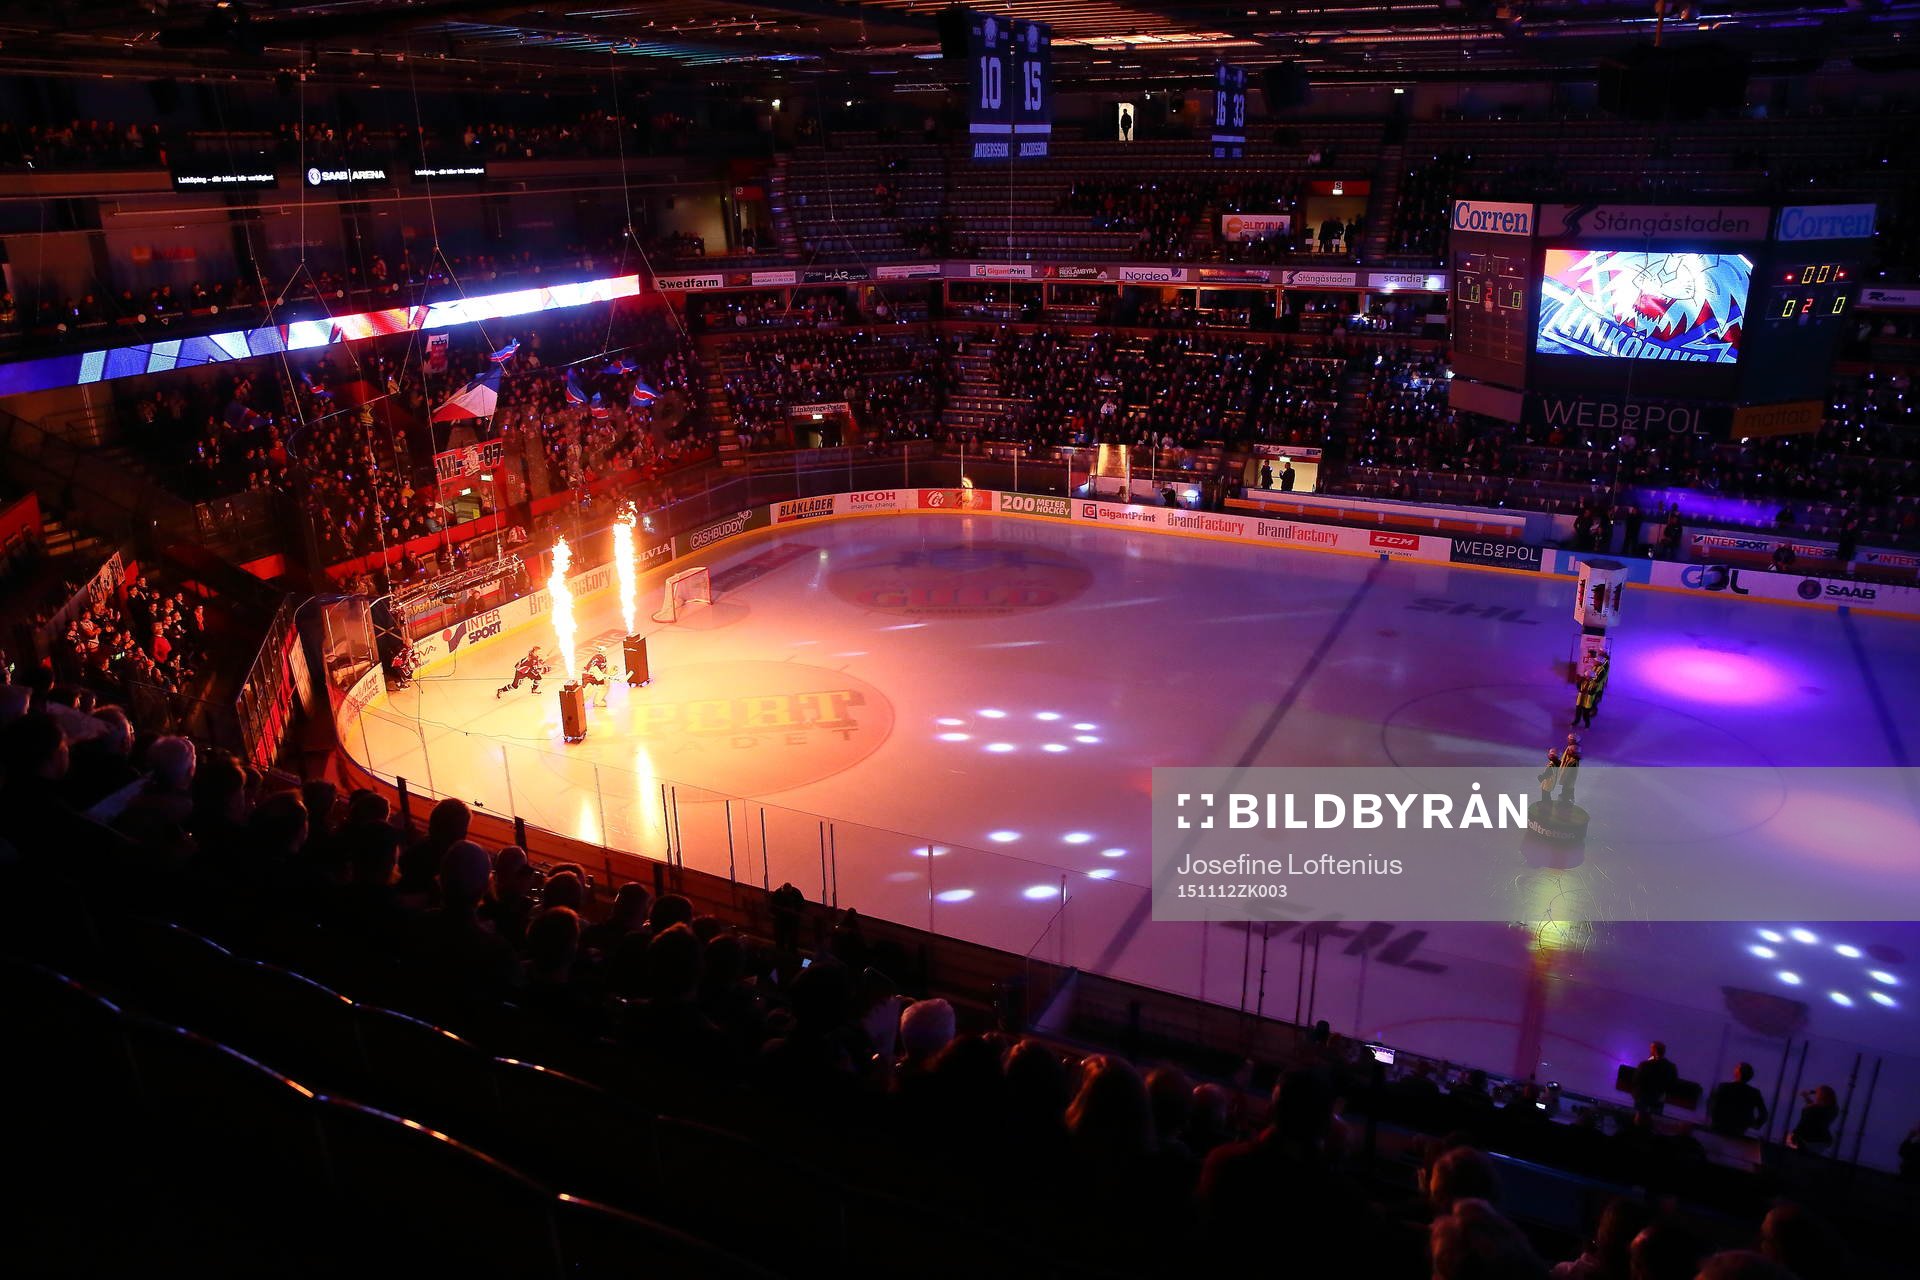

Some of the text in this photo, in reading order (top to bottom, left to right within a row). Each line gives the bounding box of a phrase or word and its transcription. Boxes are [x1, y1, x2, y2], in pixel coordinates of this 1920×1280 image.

[980, 56, 1001, 109] 10
[1023, 60, 1042, 111] 15
[1216, 91, 1226, 126] 16
[1233, 94, 1245, 127] 33
[322, 169, 386, 181] SAAB ARENA
[1455, 201, 1529, 233] Corren
[1593, 209, 1750, 237] Stångåstaden
[1779, 207, 1875, 239] Corren
[988, 267, 1026, 276] GigantPrint
[1126, 270, 1169, 281] Nordea
[1297, 272, 1352, 285] Stångåstaden
[659, 277, 719, 289] Swedfarm
[1781, 299, 1796, 317] 0
[1832, 296, 1846, 314] 0
[850, 491, 897, 503] RICOH
[1002, 495, 1036, 513] 200
[1036, 498, 1066, 509] METER
[1036, 505, 1070, 516] HOCKEY
[1099, 508, 1156, 523] GigantPrint
[692, 518, 744, 549] CASHBUDDY
[1167, 513, 1244, 537] BrandFactory
[1257, 521, 1338, 546] BrandFactory
[1373, 534, 1414, 547] CCM
[1703, 535, 1769, 552] INTERSPORT
[634, 543, 671, 562] LVIA
[1826, 584, 1876, 599] SAAB
[467, 610, 500, 632] INTER
[1404, 597, 1544, 626] SHL
[468, 621, 501, 644] SPORT
